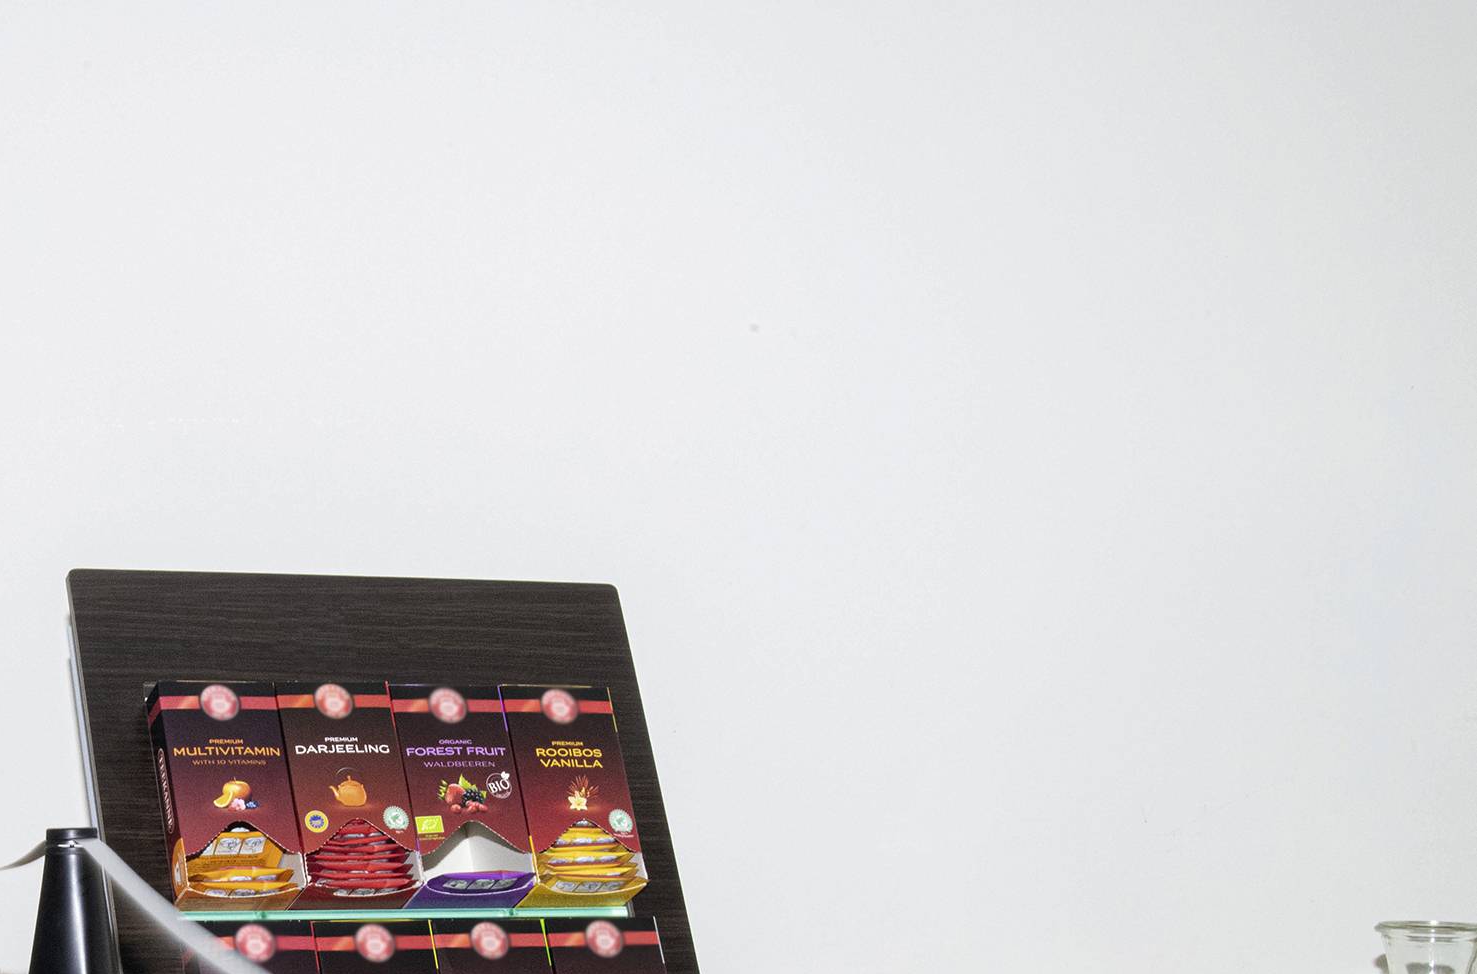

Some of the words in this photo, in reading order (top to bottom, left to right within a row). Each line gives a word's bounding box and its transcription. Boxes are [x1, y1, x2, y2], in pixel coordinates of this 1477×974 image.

[173, 746, 281, 757] MULTIVITAMIN
[294, 744, 390, 755] DARJEELING
[406, 746, 462, 757] FOREST
[466, 746, 506, 756] FRUIT
[535, 747, 603, 758] ROOIBOS
[423, 760, 496, 768] WALDBEEREN
[540, 758, 604, 769] VANILLA
[488, 778, 510, 794] BIO
